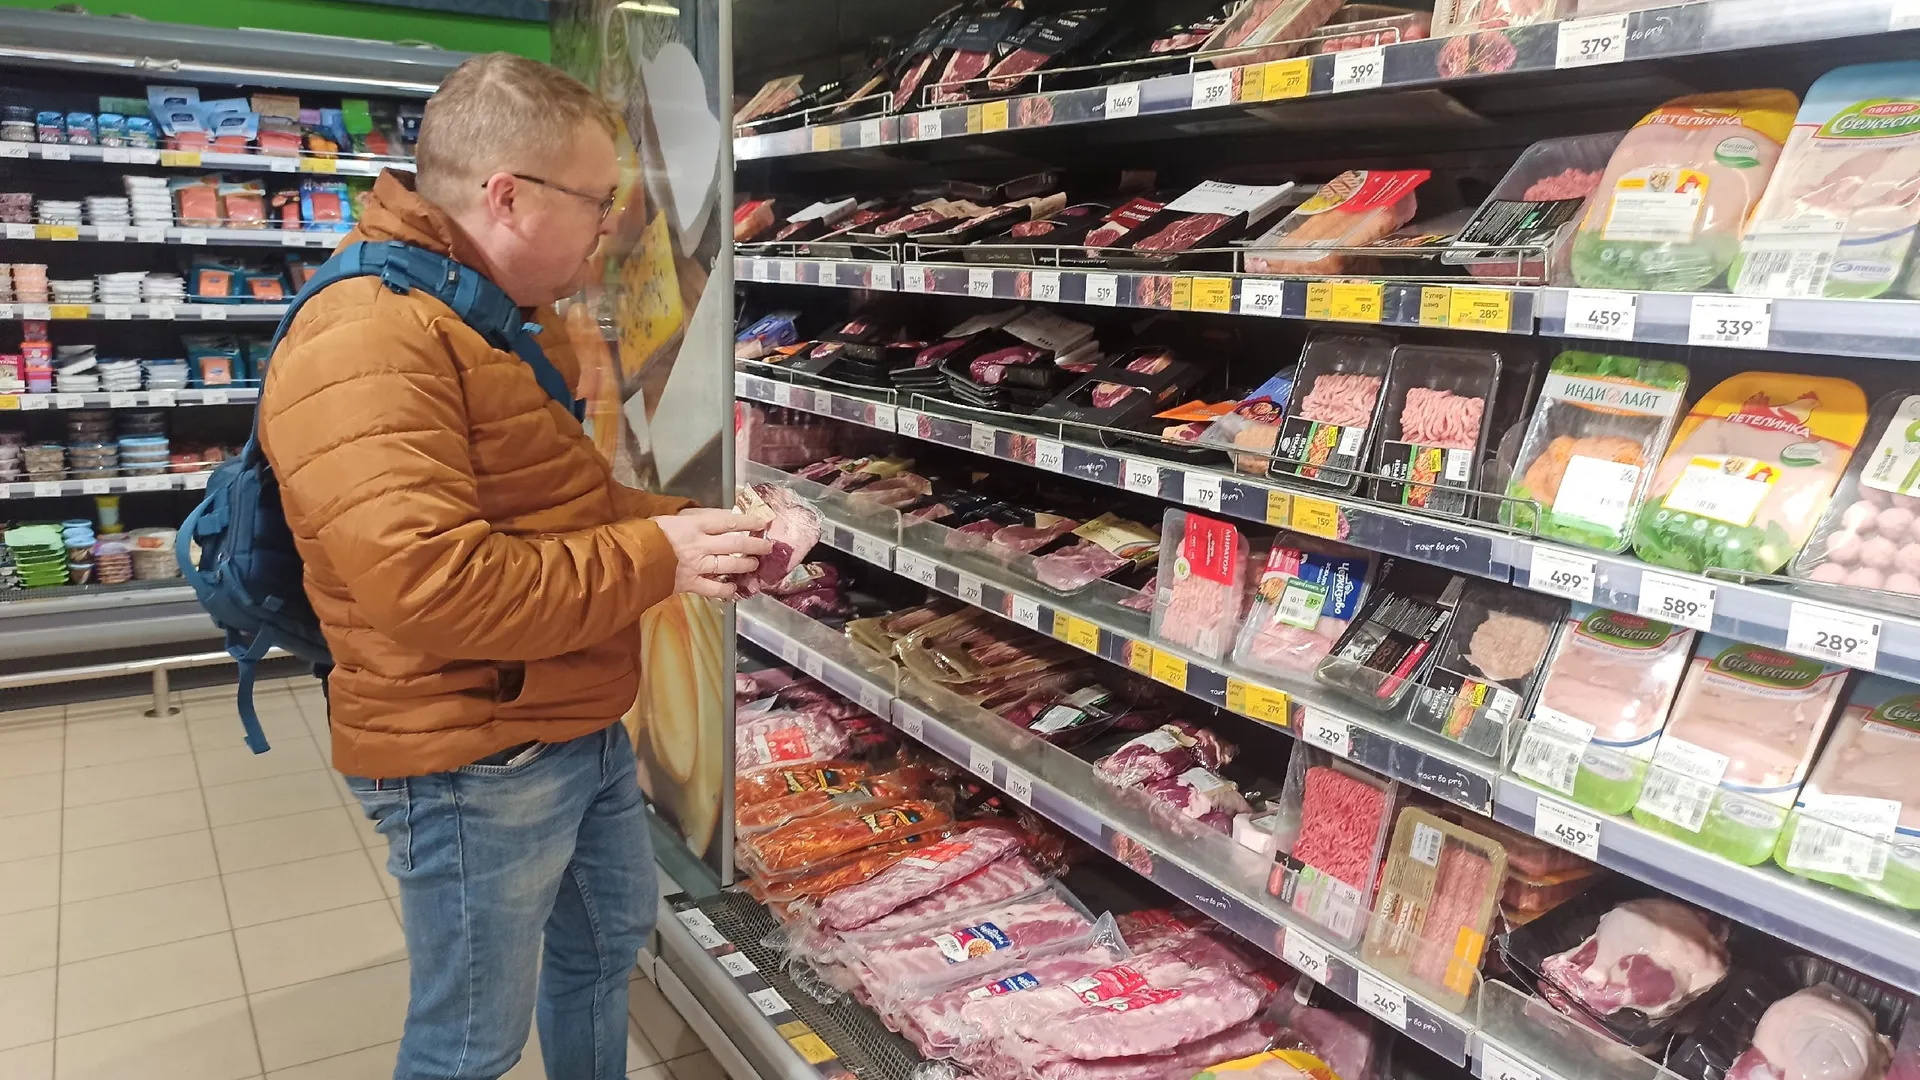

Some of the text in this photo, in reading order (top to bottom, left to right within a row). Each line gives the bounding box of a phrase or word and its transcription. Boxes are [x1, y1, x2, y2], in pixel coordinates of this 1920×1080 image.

[1580, 38, 1612, 54] 379
[1350, 63, 1374, 78] 399
[1286, 77, 1300, 86] 279
[1205, 85, 1224, 98] 359
[1112, 96, 1133, 109] 1449
[1867, 104, 1914, 114] первая
[1647, 113, 1743, 126] ПЕТЕЛИНКА
[973, 281, 988, 291] 3799
[1041, 284, 1055, 296] 759
[1097, 287, 1111, 298] 519
[1212, 295, 1223, 304] 319
[1255, 294, 1274, 306] 259
[1479, 309, 1498, 319] 289
[1588, 310, 1621, 326] 459
[1716, 319, 1753, 335] 339
[1565, 382, 1661, 409] ИНДИ ЛАЙТ
[1726, 412, 1811, 438] ПЕТЕЛИНКА
[1040, 453, 1058, 465] 2749
[1133, 472, 1152, 485] 1259
[1198, 489, 1214, 500] 179
[1317, 517, 1329, 526] 159
[1436, 541, 1445, 551] во
[1445, 544, 1460, 552] рту
[1551, 570, 1582, 588] 499
[1662, 597, 1698, 617] 589
[1019, 608, 1034, 620] 1149
[1587, 616, 1660, 641] Свежесть
[1815, 631, 1857, 653] 289
[1719, 653, 1809, 680] Свежесть
[1267, 704, 1280, 714] 279
[1318, 727, 1340, 742] 229
[1437, 774, 1446, 783] во
[1447, 779, 1463, 787] рту
[1013, 780, 1026, 795] 1169
[1555, 823, 1586, 844] 459
[1299, 950, 1319, 970] 799
[1373, 993, 1397, 1013] 249
[1423, 1023, 1437, 1034] рту
